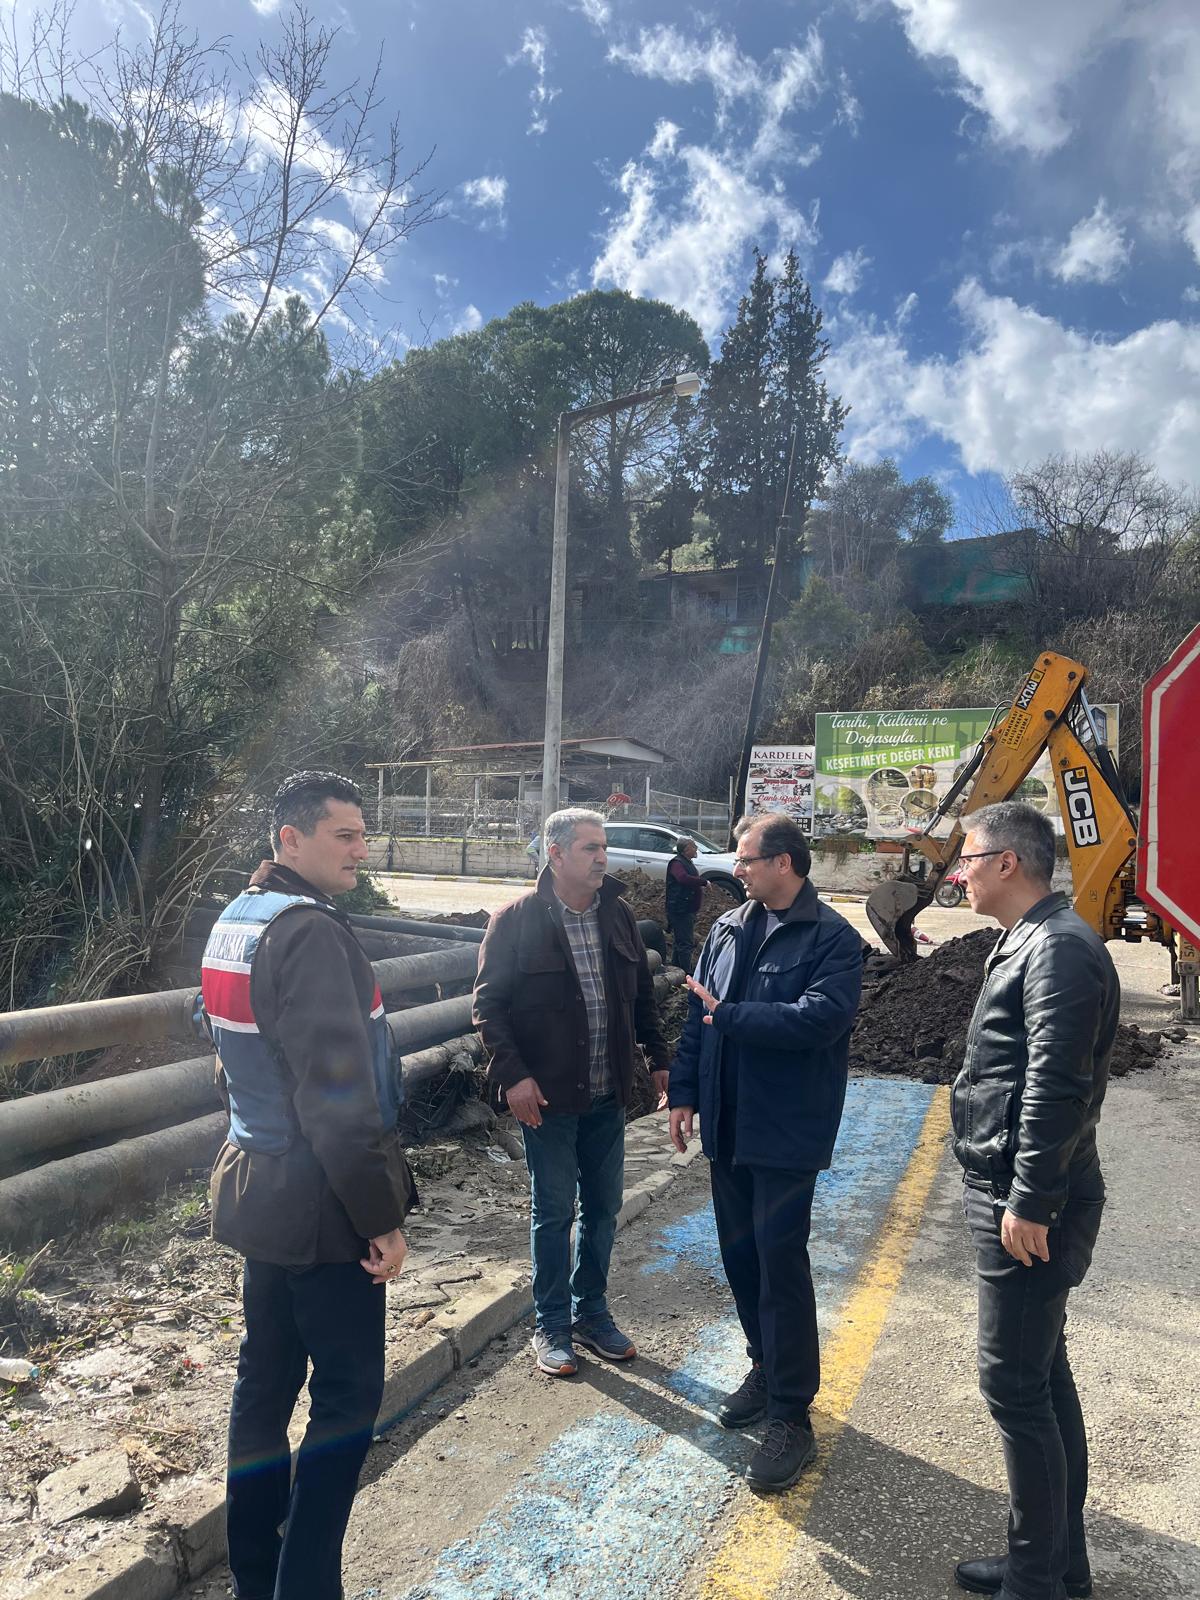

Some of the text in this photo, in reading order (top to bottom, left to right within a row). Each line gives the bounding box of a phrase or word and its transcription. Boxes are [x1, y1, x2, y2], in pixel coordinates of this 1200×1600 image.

[829, 713, 948, 729] Tarihi, Kültürü ve
[754, 751, 812, 760] KARDELEN
[826, 745, 956, 772] KEŞFETMEYE DEĞER KENT
[1064, 770, 1098, 846] JCB
